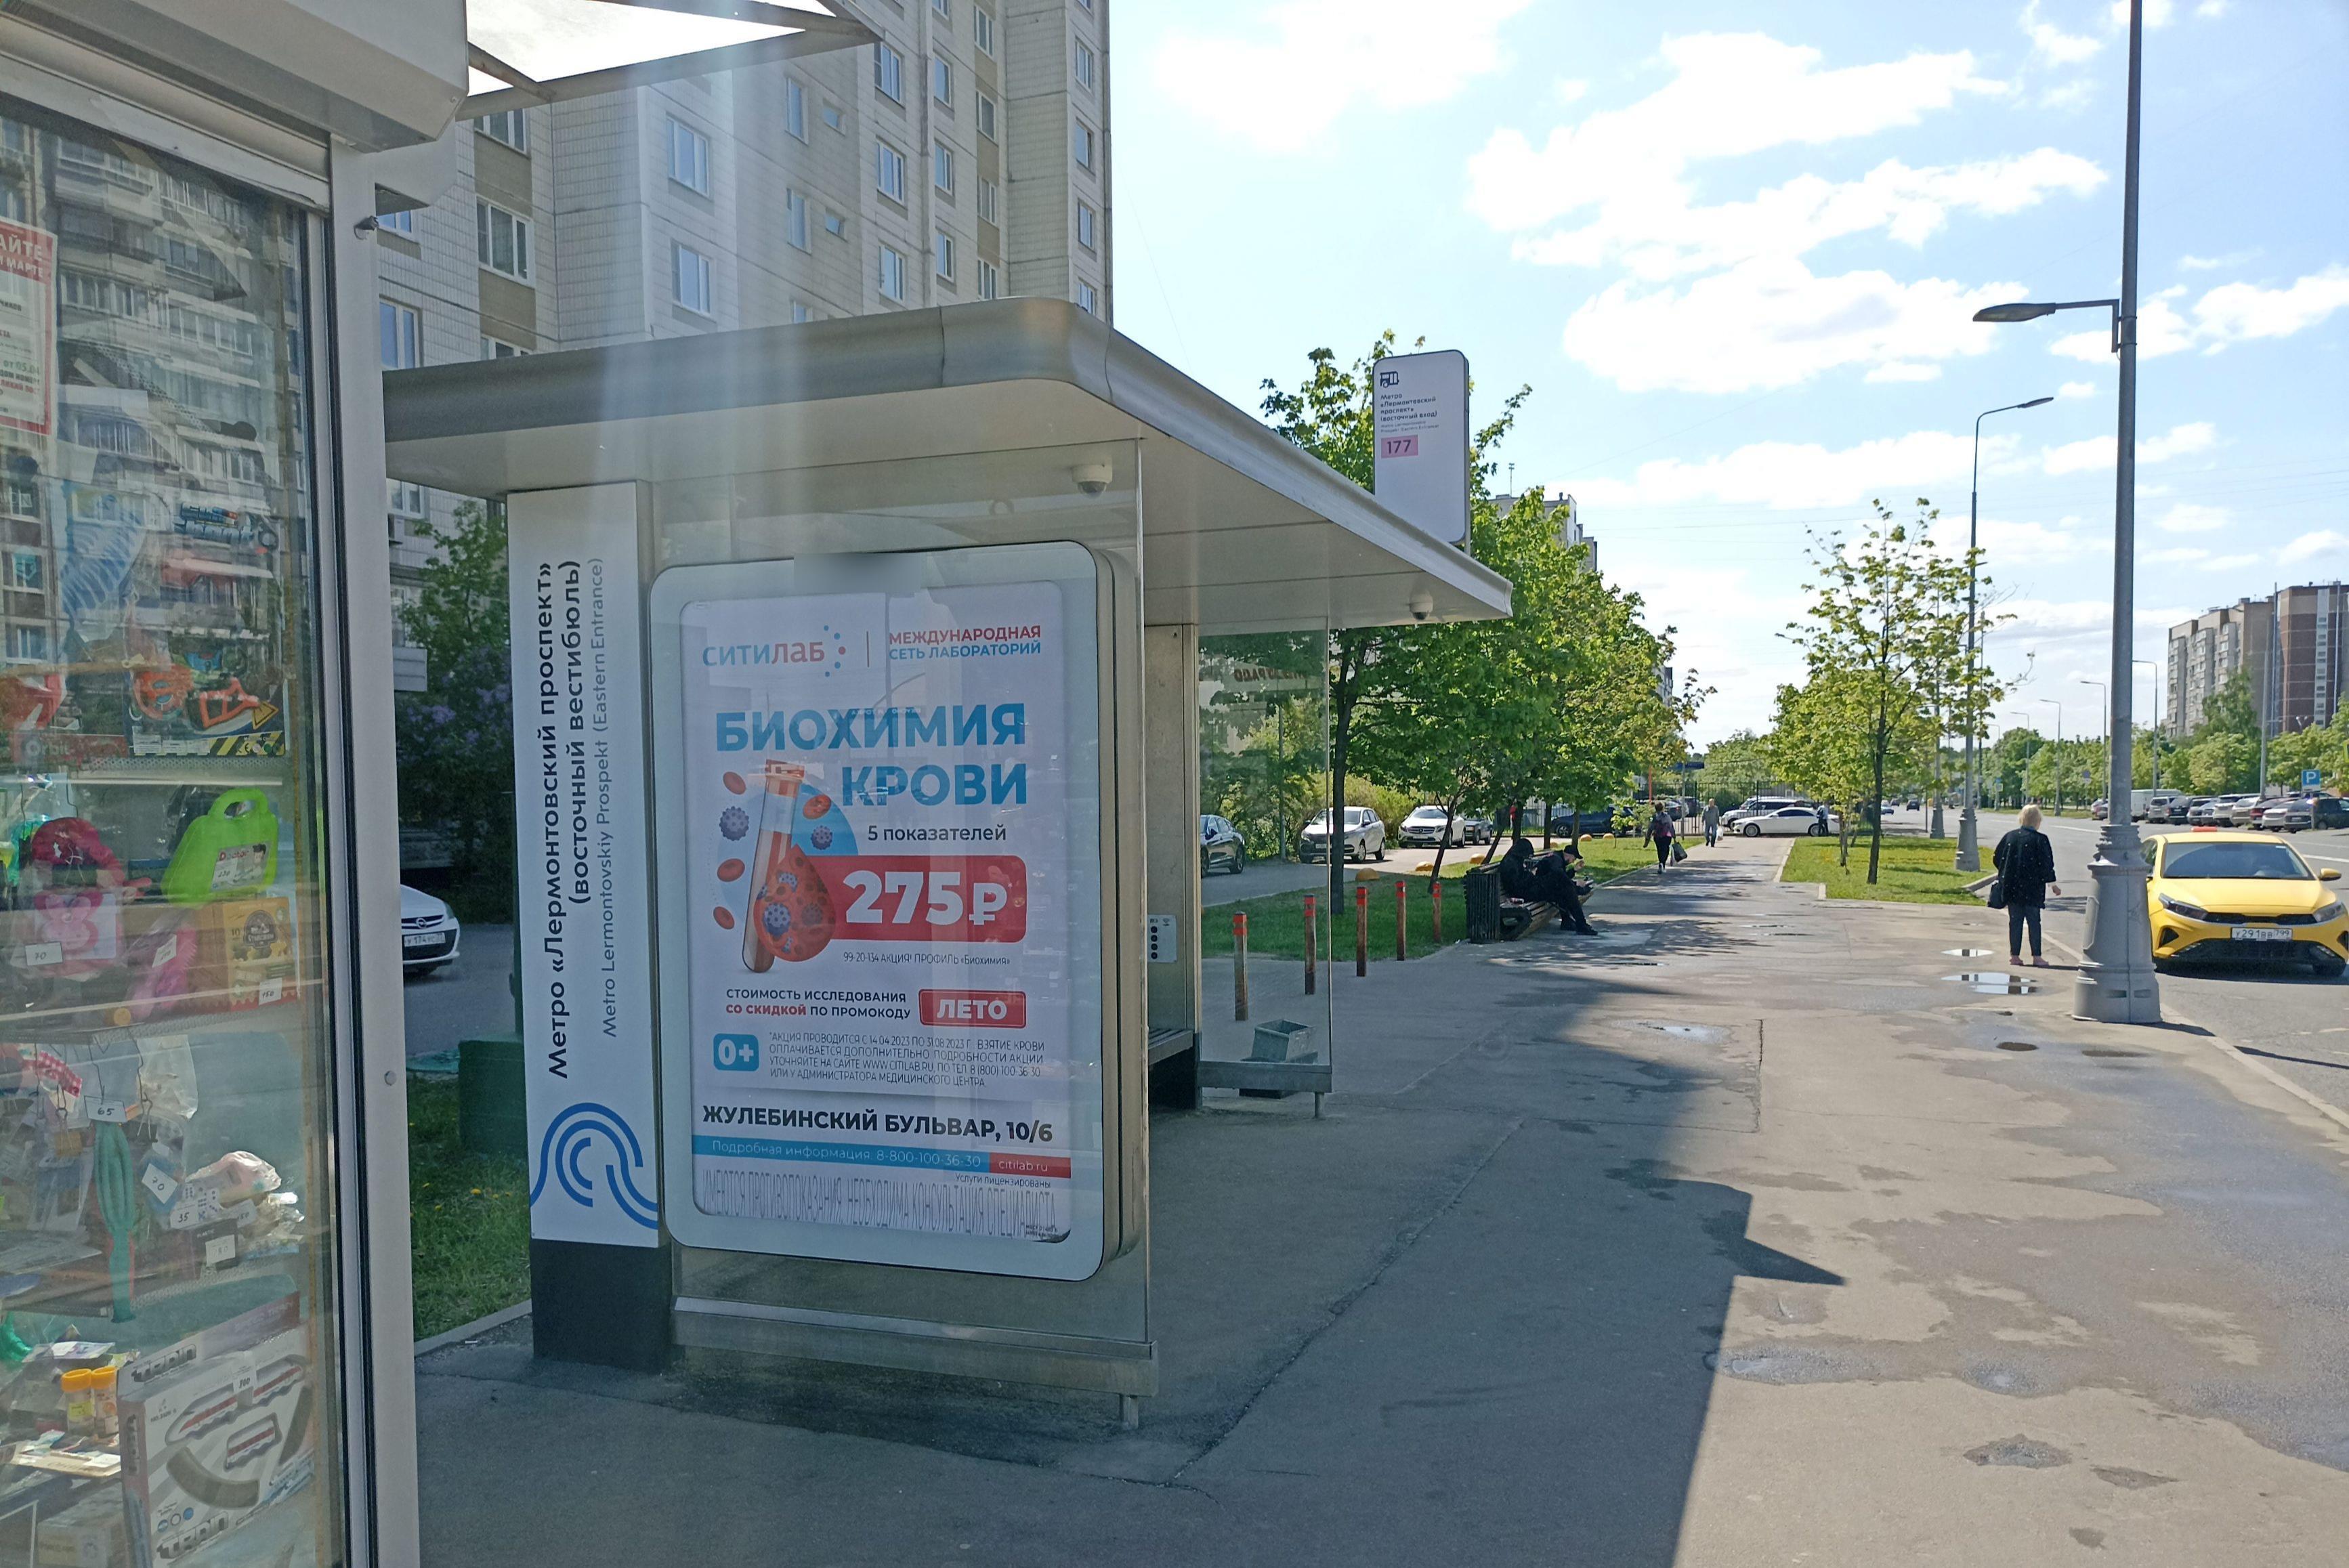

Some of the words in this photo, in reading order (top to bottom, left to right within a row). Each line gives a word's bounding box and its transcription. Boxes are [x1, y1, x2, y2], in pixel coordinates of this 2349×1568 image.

[6, 257, 44, 278] МАРТЕ
[1387, 440, 1412, 454] 177
[587, 557, 606, 649] Entrance)
[537, 563, 559, 715] проспект»
[557, 561, 584, 731] вестибюль)
[889, 625, 1041, 645] МЕЖДУНАРОДНАЯ
[889, 648, 925, 660] СЕТЬ
[929, 641, 1041, 659] ЛАБОРАТОРИЙ
[593, 652, 609, 732] (Eastern
[716, 702, 1027, 752] БИОХИМИЯ
[594, 740, 612, 825] Prospekt
[842, 763, 1027, 807] КРОВИ
[566, 740, 591, 904] (восточный
[868, 827, 879, 841] 5
[883, 825, 1007, 841] показателей
[537, 728, 567, 973] «Лермонтовский
[597, 830, 615, 972] Lermontovskiy
[843, 952, 879, 962] 99-20-134
[914, 953, 959, 965] ПРОФИЛЬ
[960, 954, 1011, 965] «Биохимия»
[602, 978, 617, 1038] Metro
[726, 989, 801, 1000] СТОИМОСТЬ
[804, 990, 906, 1004] ИССЛЕДОВАНИЯ
[726, 1003, 743, 1015] СО
[746, 1002, 807, 1017] СКИДКОЙ
[810, 1005, 828, 1016] ПО
[831, 1007, 911, 1020] ПРОМОКОДУ
[937, 999, 1008, 1021] ЛЕТО
[548, 981, 570, 1079] Метро
[803, 1033, 860, 1044] ПРОВОДИТСЯ
[862, 1036, 868, 1044] С
[912, 1036, 925, 1046] ПО
[977, 1040, 1011, 1050] ВЗЯТИЕ
[1014, 1040, 1044, 1051] КРОВИ
[718, 1039, 755, 1065] 0+
[769, 1044, 841, 1056] ОПЛАЧИВАЕТСЯ
[934, 1050, 1007, 1063] ПОДРОБНОСТИ
[1009, 1054, 1043, 1065] АКЦИИ
[769, 1055, 818, 1067] УТОЧНЯЙТЕ
[820, 1058, 832, 1068] НА
[833, 1057, 860, 1069] САЙТЕ
[937, 1063, 950, 1073] ПО
[970, 1064, 975, 1076] 8
[977, 1065, 998, 1078] (800)
[770, 1068, 789, 1078] ИЛИ
[790, 1069, 796, 1078] У
[797, 1069, 876, 1081] АДМИНИСТРАТОРА
[879, 1072, 950, 1085] МЕДИЦИНСКОГО
[98, 1107, 115, 1116] 65
[702, 1105, 878, 1132] ЖУЛЕБИНСКИЙ
[885, 1114, 1001, 1142] БУЛЬВАР,
[1006, 1120, 1053, 1143] 10/6
[712, 1139, 782, 1155] Подробная
[876, 1149, 981, 1168] 8-800-100-36-30
[955, 1172, 982, 1184] Услуги
[984, 1174, 1051, 1189] лицензированы
[702, 1169, 745, 1217] ИМЕЮТСЯ
[847, 1177, 909, 1229] НЕОБХОДИМА
[912, 1181, 983, 1233] КОНСУЛЬТАЦИЯ
[988, 1188, 1057, 1239] СПЕЦИАЛИСТА
[177, 1212, 190, 1223] 35
